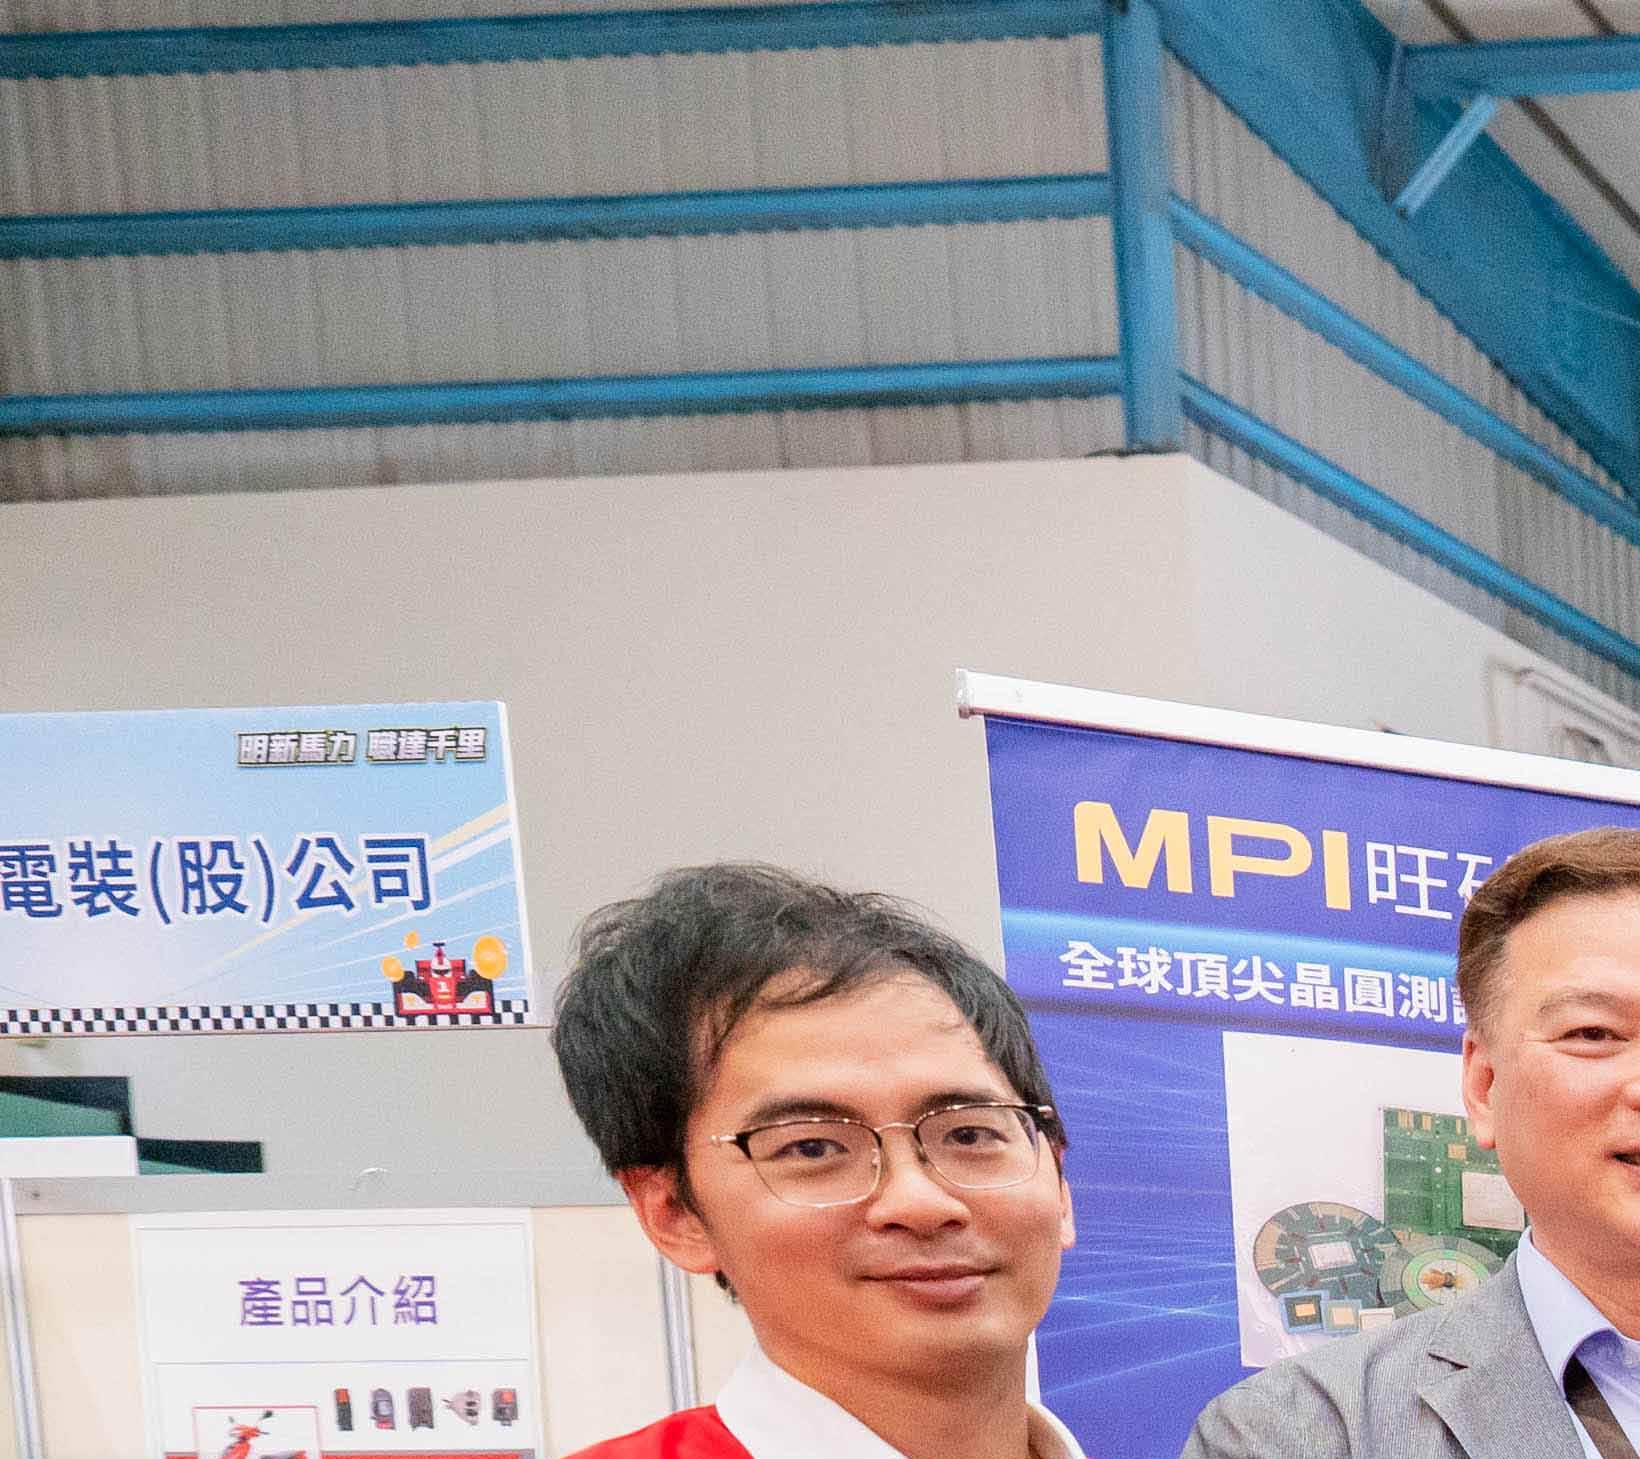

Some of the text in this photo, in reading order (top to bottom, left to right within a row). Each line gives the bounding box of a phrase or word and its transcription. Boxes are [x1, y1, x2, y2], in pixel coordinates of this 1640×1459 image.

[236, 730, 487, 764] 明新馬力 職達千里
[0, 836, 432, 926] 電裝(股)公司
[1073, 800, 1352, 911] MPI
[238, 1275, 439, 1328] 產品介紹
